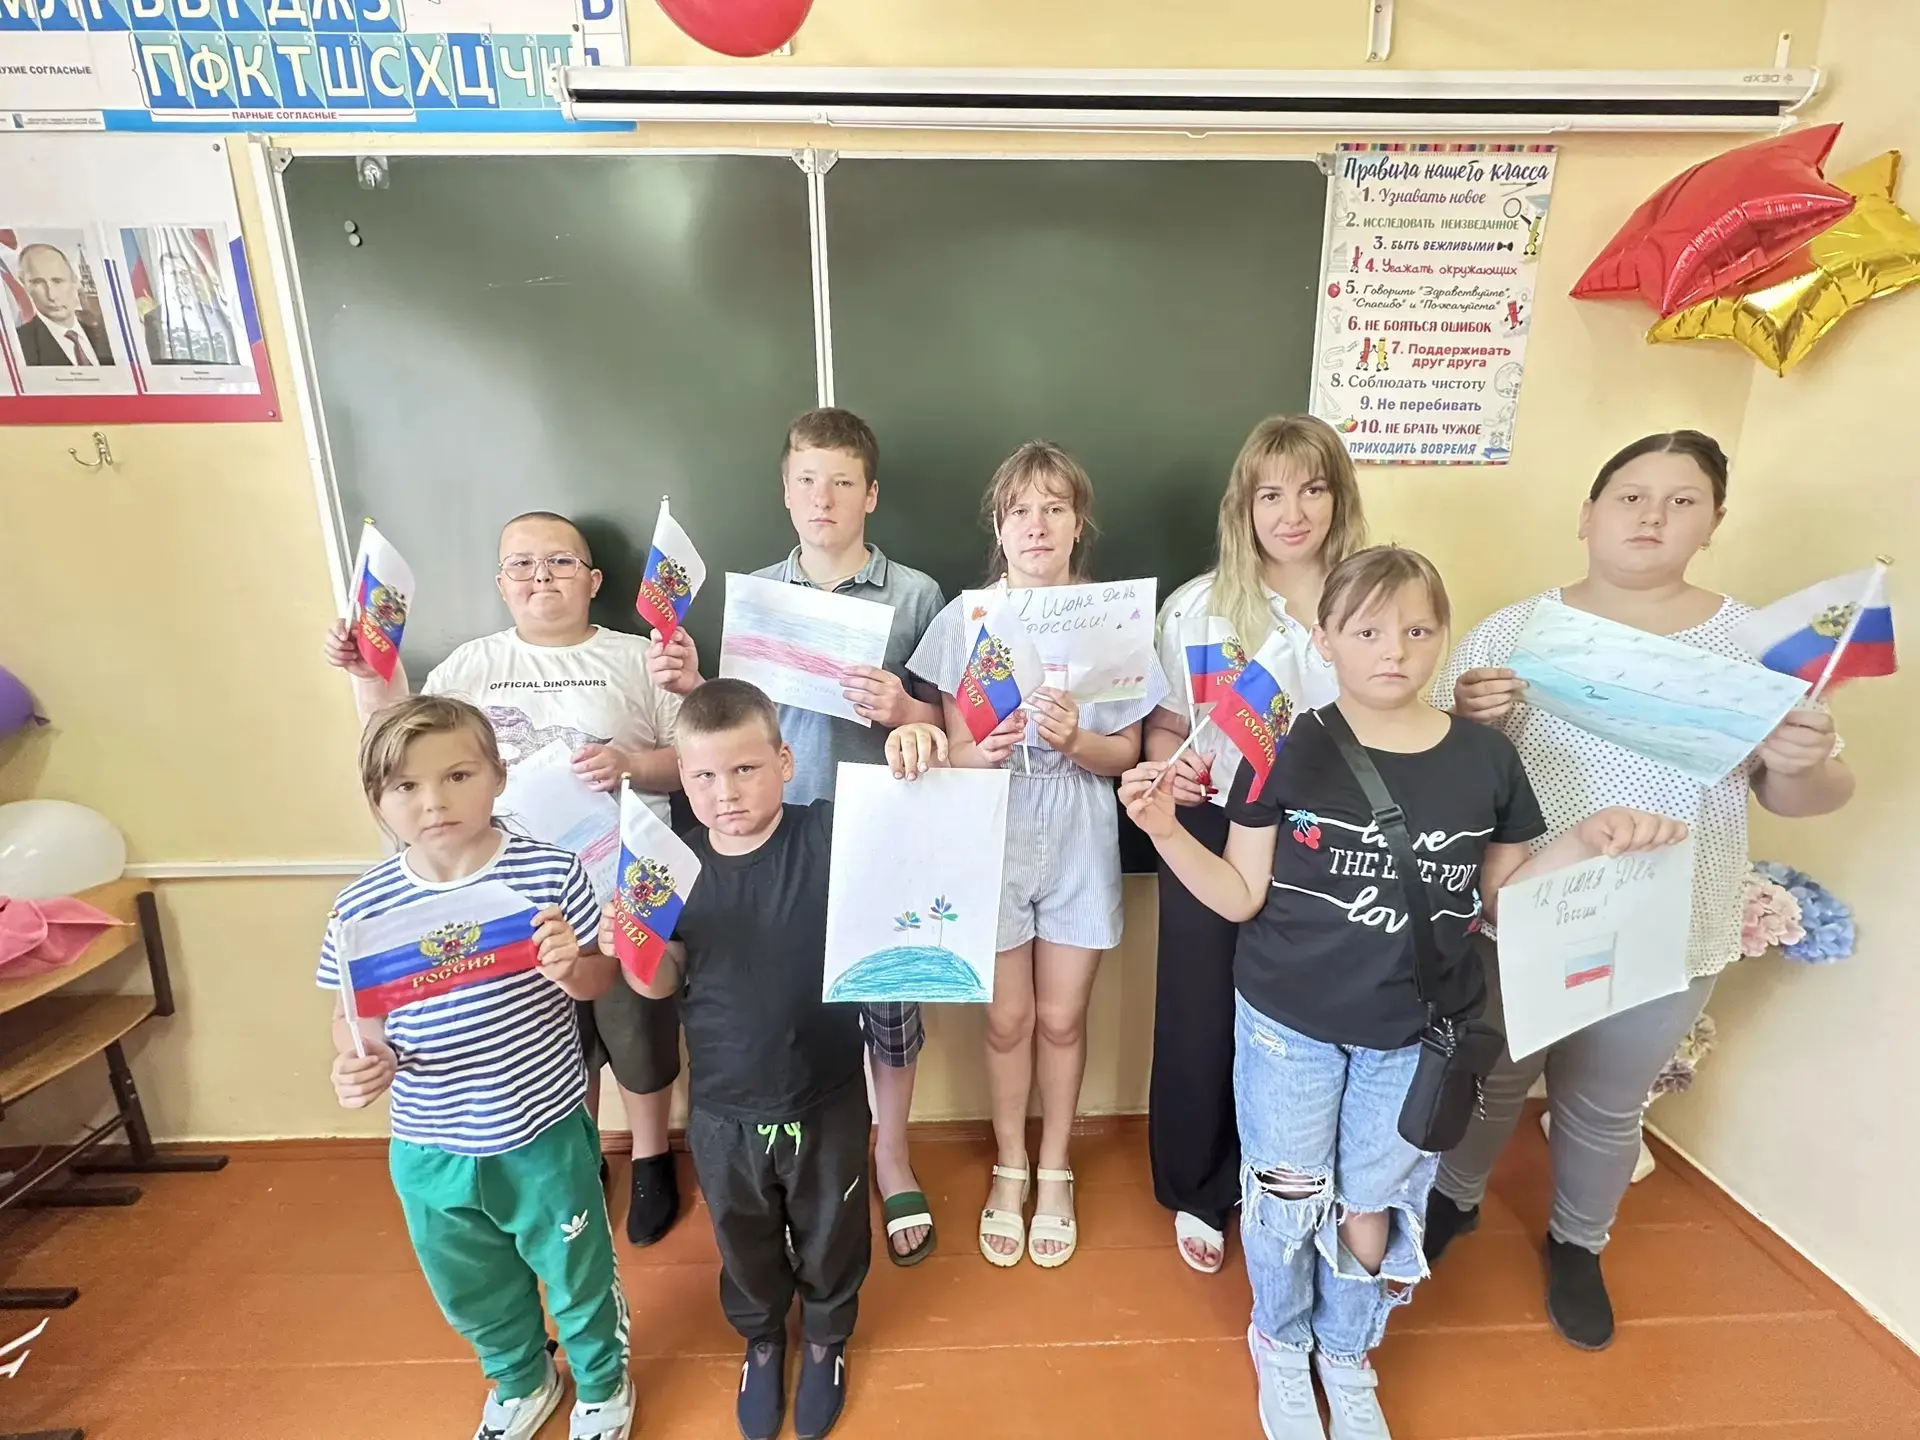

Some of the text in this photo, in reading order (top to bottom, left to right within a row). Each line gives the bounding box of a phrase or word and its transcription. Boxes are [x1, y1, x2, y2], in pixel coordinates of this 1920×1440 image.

[29, 65, 92, 75] СОГЛАСНЫЕ
[231, 111, 337, 120] ПАРНЫЕ СОГЛАСНЫЕ
[1343, 155, 1549, 188] Правила нашего класса
[1362, 187, 1486, 206] 1. Узнавать новое
[1345, 212, 1520, 231] 2. ИССЛЕДОВАТЬ НЕИЗВЕДАННОЕ
[1373, 235, 1496, 252] 3. БЫТЬ ВЕЖЛИВЫМИ
[1365, 258, 1518, 279] 4. Уважать окружающих
[1345, 280, 1359, 294] 5.
[1362, 284, 1416, 298] Говорить
[1348, 316, 1492, 333] 6. НЕ БОЯТЬСЯ ОШИБОК
[1391, 341, 1511, 356] 7. Поддерживать
[1412, 357, 1487, 368] друг друга
[1330, 372, 1486, 392] 8. Соблюдать чистоту
[1360, 395, 1482, 412] 9. Не перебивать
[1360, 419, 1482, 435] 10. НЕ БРАТЬ ЧУЖОЕ
[1349, 442, 1477, 455] ПРИХОДИТЬ ВОВРЕМЯ
[489, 679, 607, 690] OFFICIAL DINOSAURS
[1328, 846, 1380, 878] THE
[412, 953, 497, 988] РОССИЯ
